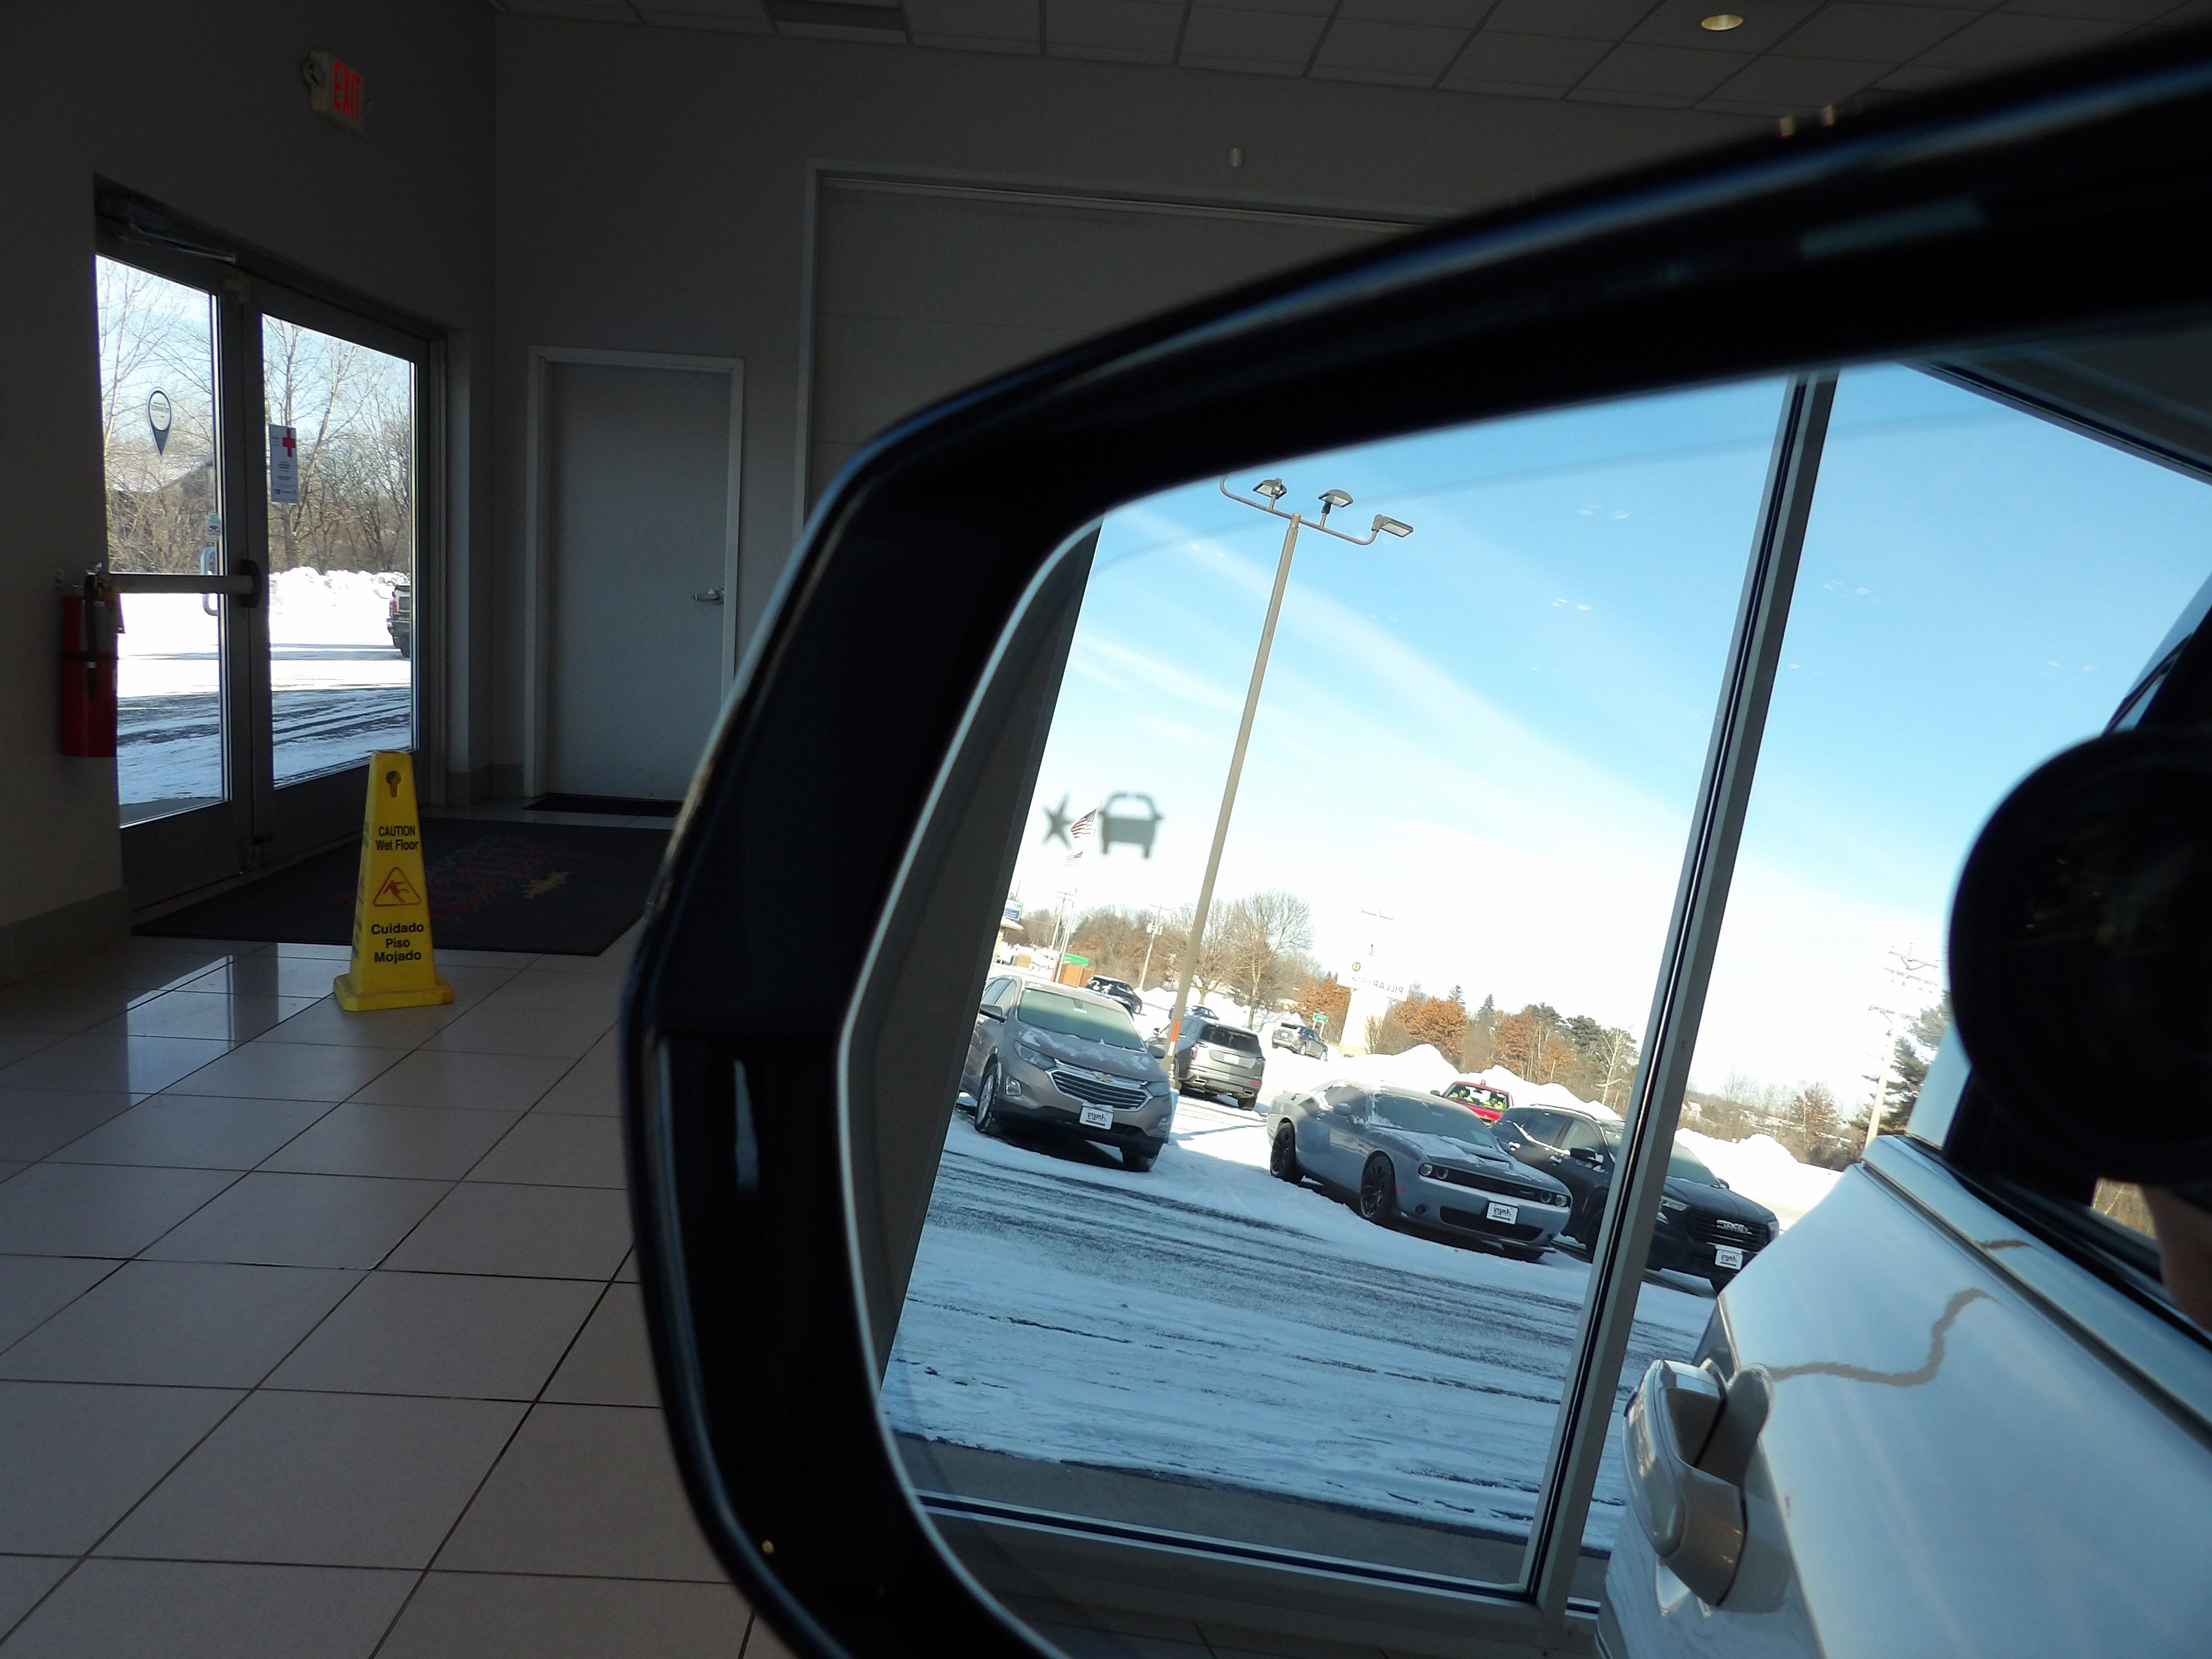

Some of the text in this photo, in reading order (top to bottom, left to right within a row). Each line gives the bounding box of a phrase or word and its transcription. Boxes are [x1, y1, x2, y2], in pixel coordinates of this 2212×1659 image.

[334, 60, 361, 120] EXIT
[379, 825, 415, 836] CAUTION
[376, 839, 419, 851] Wet Floor
[371, 923, 424, 935] Cuidado
[386, 938, 410, 948] Piso
[374, 950, 421, 964] Mojado
